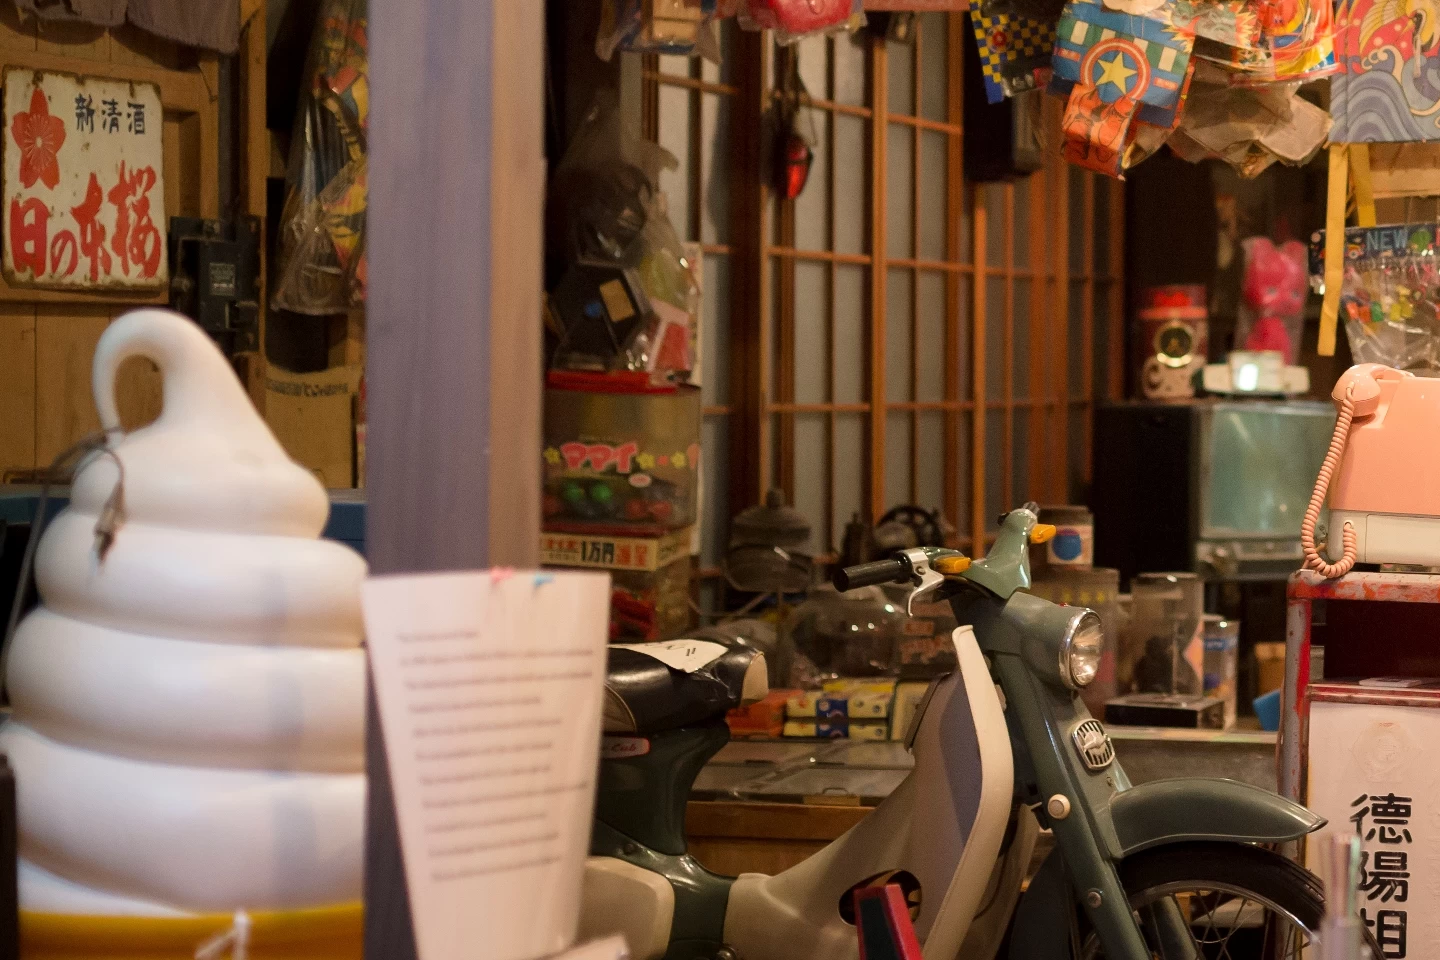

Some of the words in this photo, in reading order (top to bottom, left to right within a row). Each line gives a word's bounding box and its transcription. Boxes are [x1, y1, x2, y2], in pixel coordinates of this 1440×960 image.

[74, 93, 146, 135] 新清酒
[1366, 228, 1409, 252] NEW
